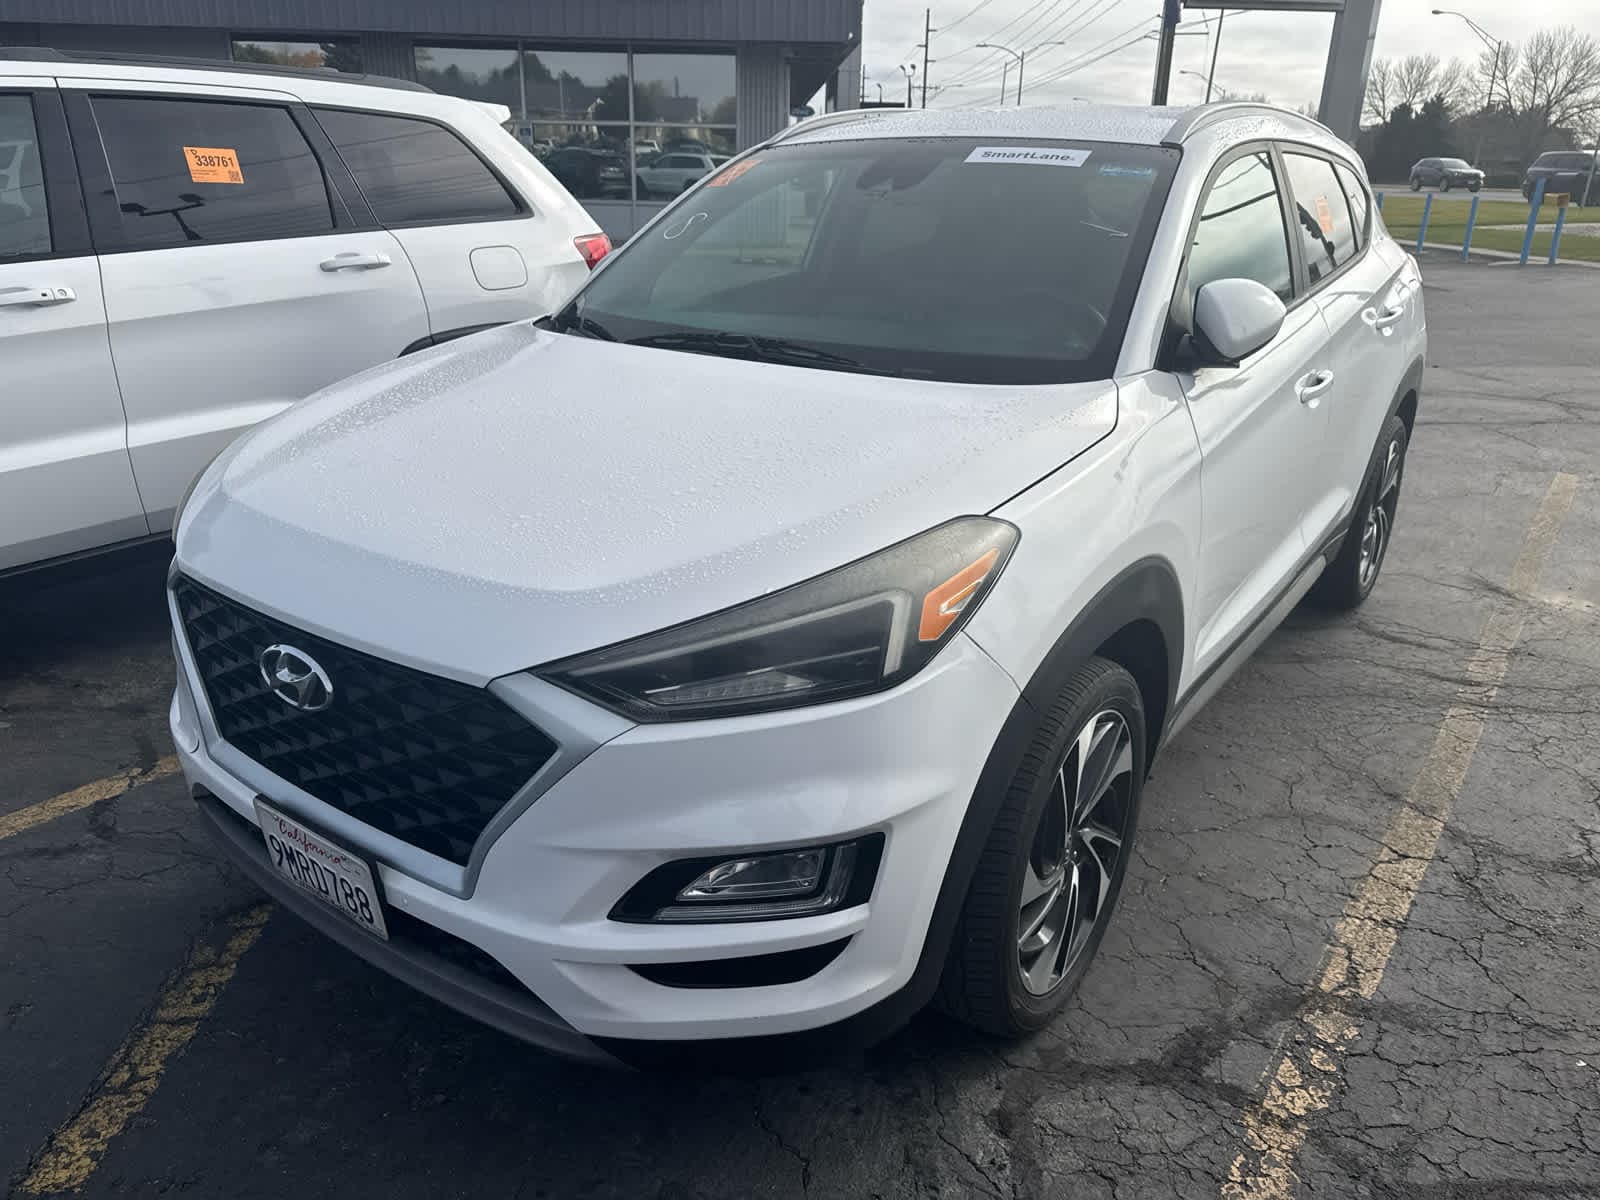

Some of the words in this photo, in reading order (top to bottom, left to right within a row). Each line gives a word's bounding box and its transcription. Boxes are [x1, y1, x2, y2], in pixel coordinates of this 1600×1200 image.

[195, 155, 234, 168] 338761
[981, 151, 1071, 161] SmartLane
[278, 819, 341, 864] California
[269, 834, 374, 924] 9MRD788
